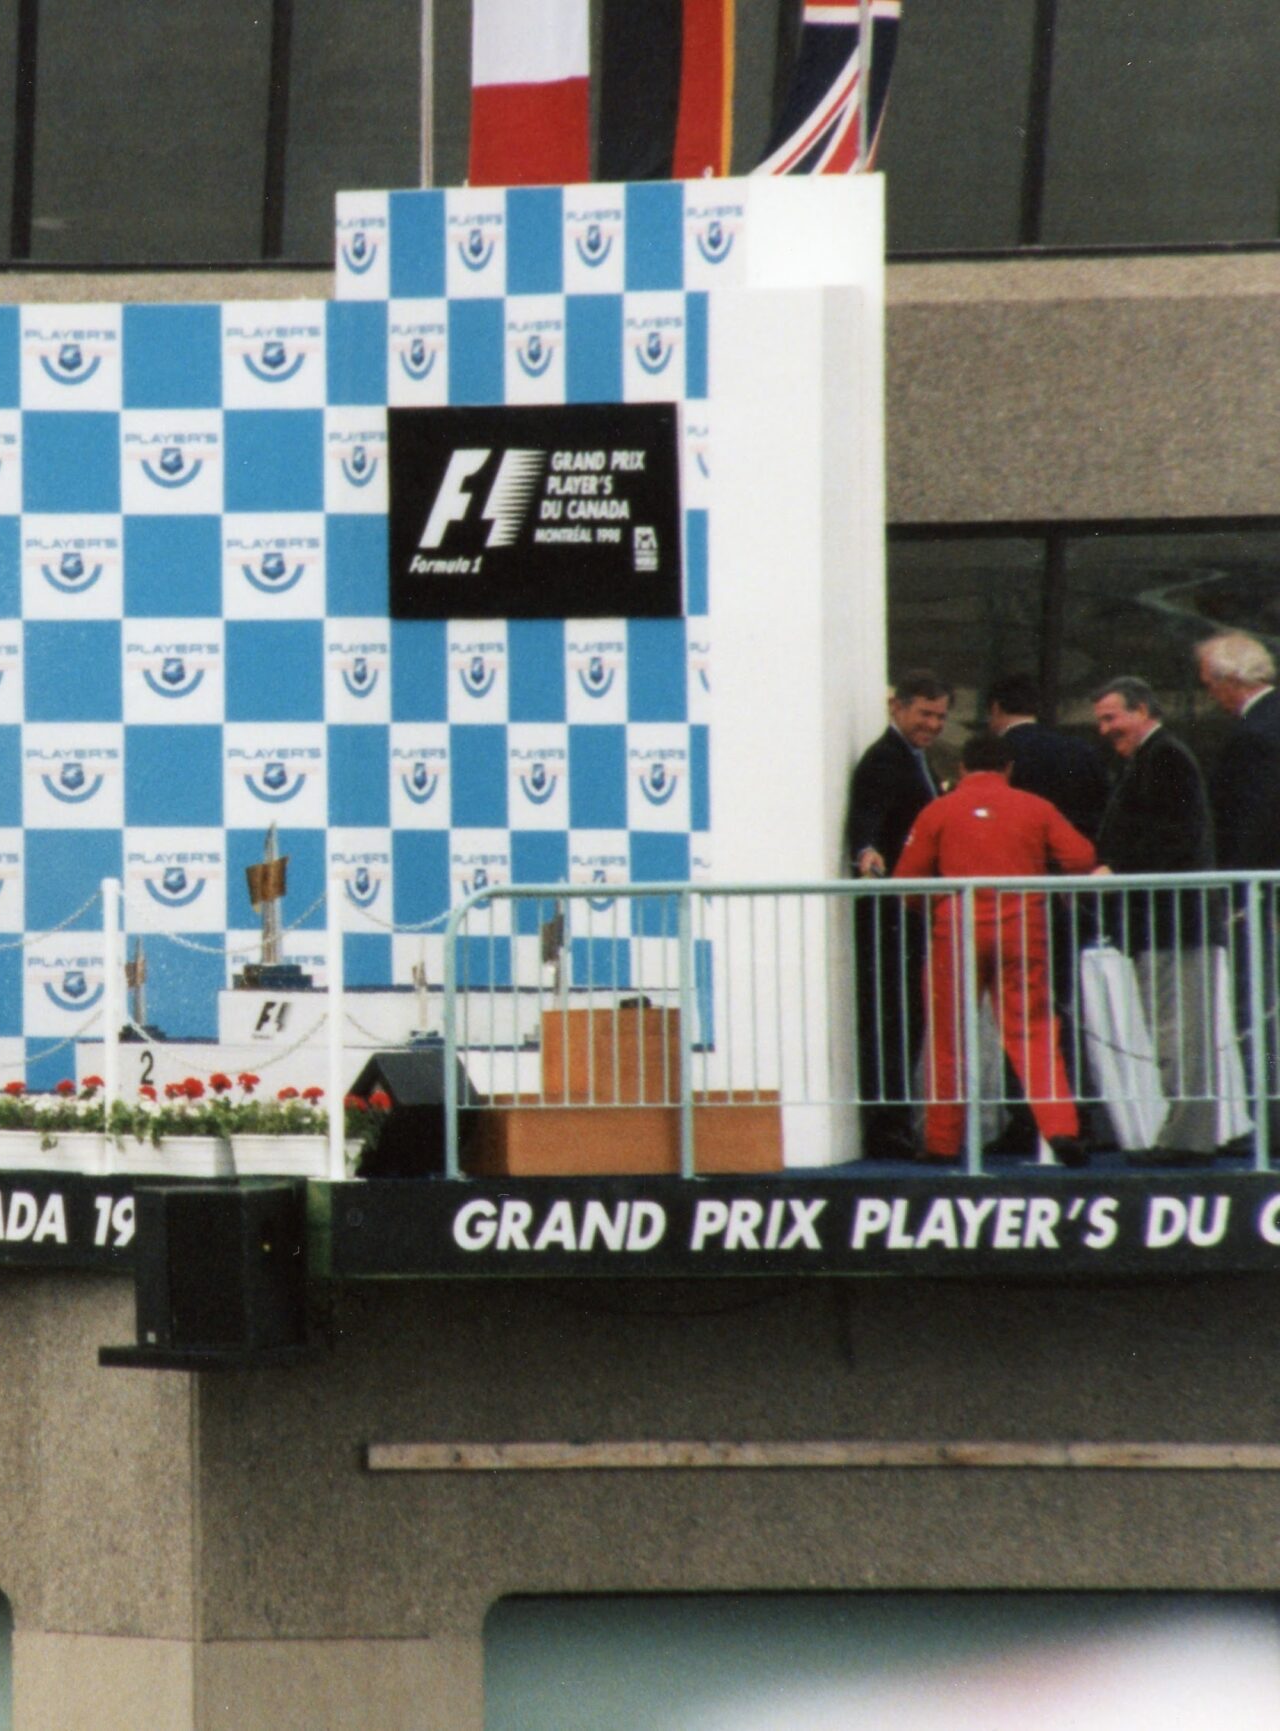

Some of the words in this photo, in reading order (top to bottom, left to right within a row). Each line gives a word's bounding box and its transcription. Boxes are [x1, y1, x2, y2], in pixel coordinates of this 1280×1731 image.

[552, 451, 606, 471] GRAND
[611, 450, 646, 471] PRIX
[547, 475, 613, 496] PLAYER'S
[419, 449, 546, 548] F1
[540, 500, 562, 520] DU
[567, 500, 630, 520] CANADA
[409, 554, 470, 574] Formula
[27, 957, 103, 968] PLAYER
[140, 1050, 154, 1085] 2
[452, 1199, 667, 1252] GRAND
[690, 1199, 827, 1251] PRIX
[851, 1196, 1119, 1250] PLAYER'S
[1146, 1195, 1231, 1249] DU
